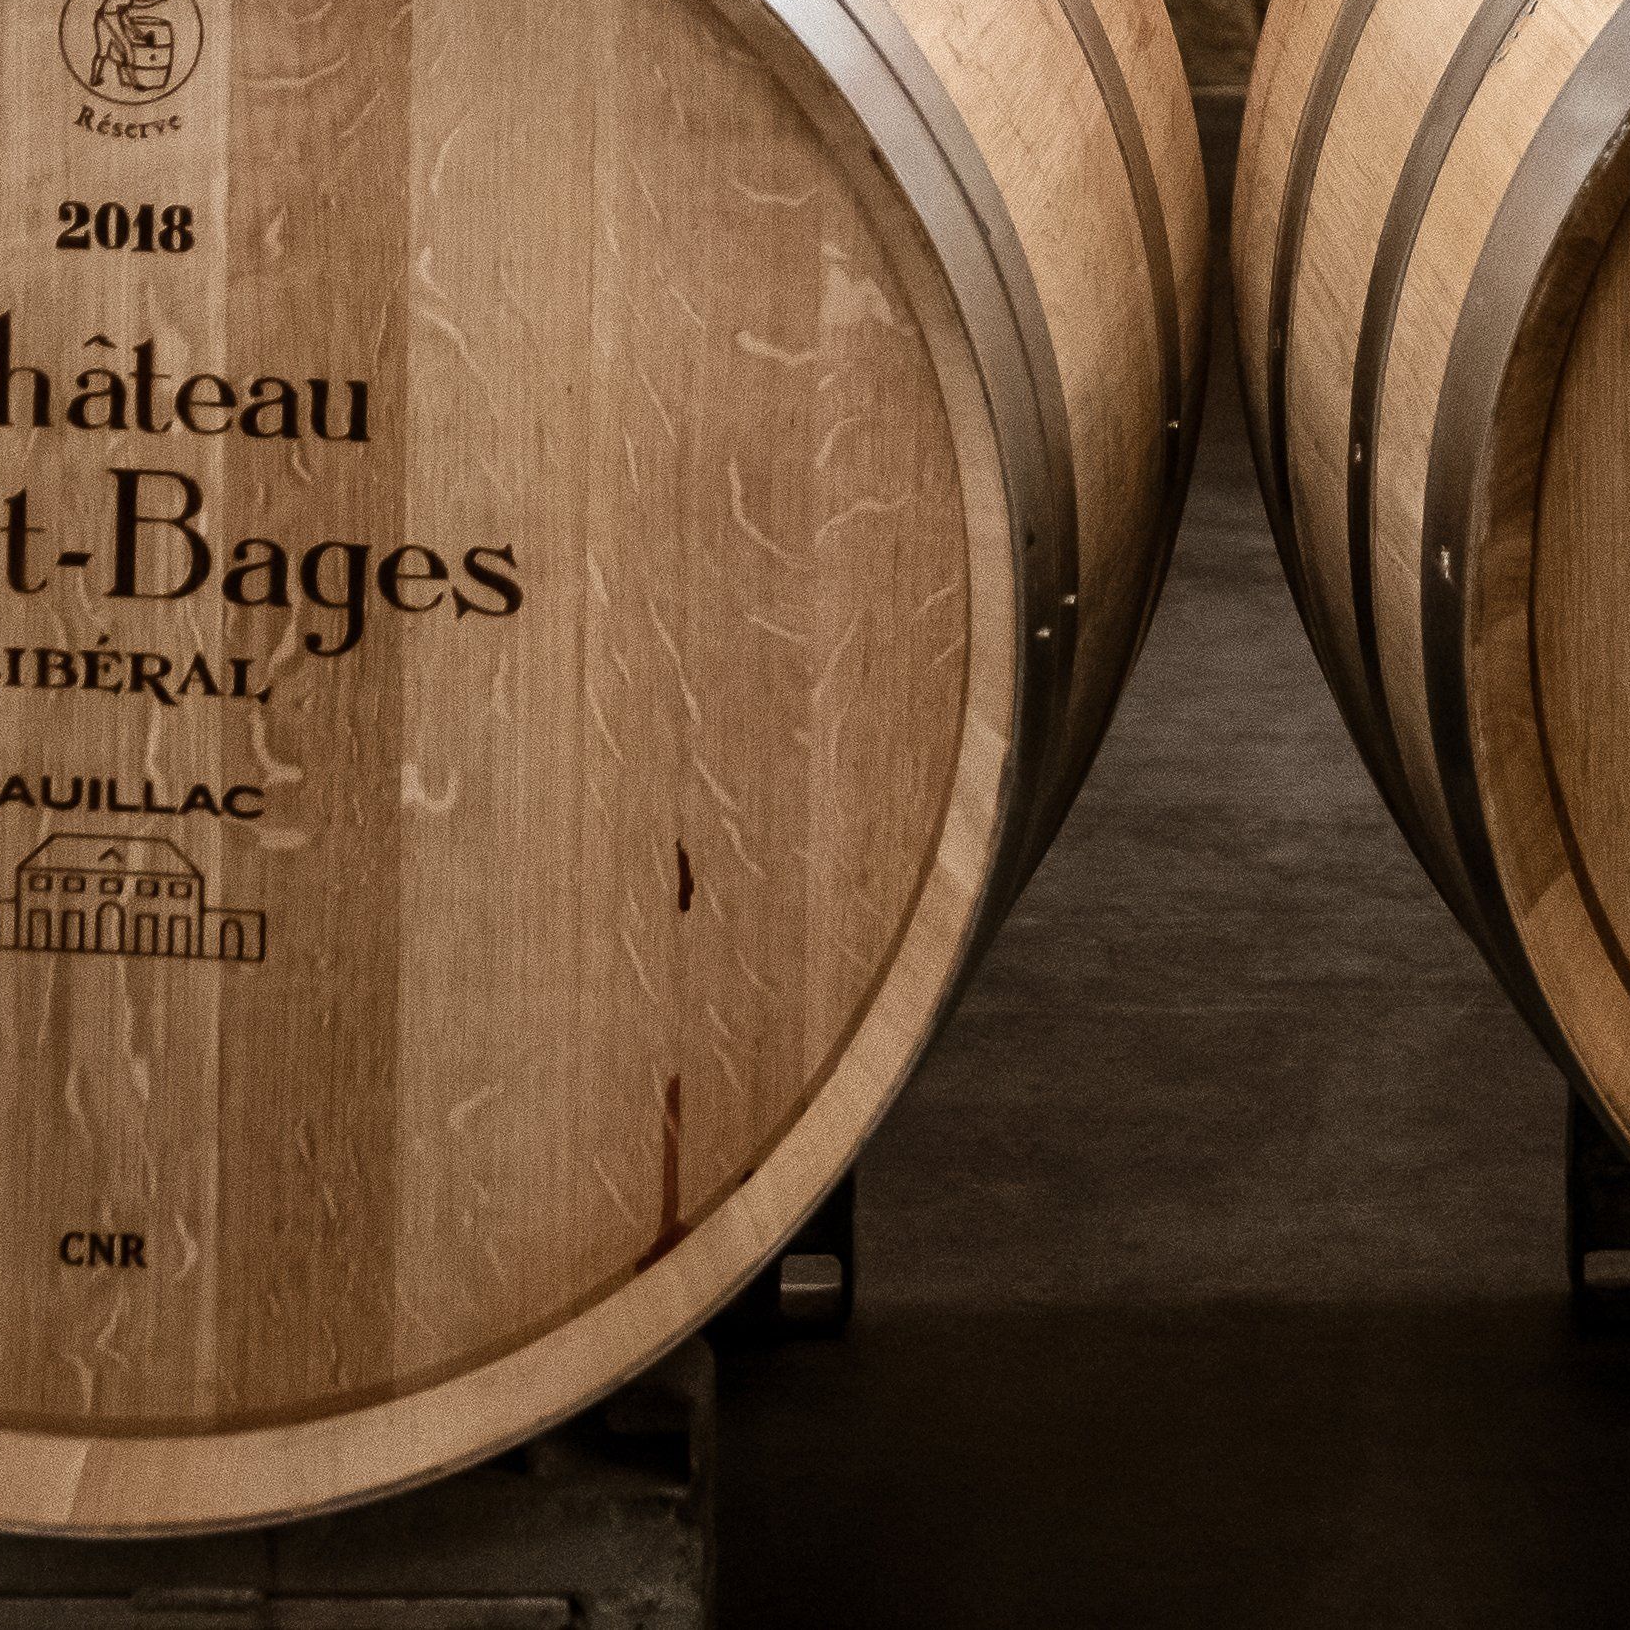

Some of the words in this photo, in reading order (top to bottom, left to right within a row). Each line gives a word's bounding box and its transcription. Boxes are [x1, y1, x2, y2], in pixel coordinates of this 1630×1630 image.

[73, 104, 182, 141] Réserve
[56, 201, 195, 253] 2018
[58, 1232, 145, 1268] CNR
